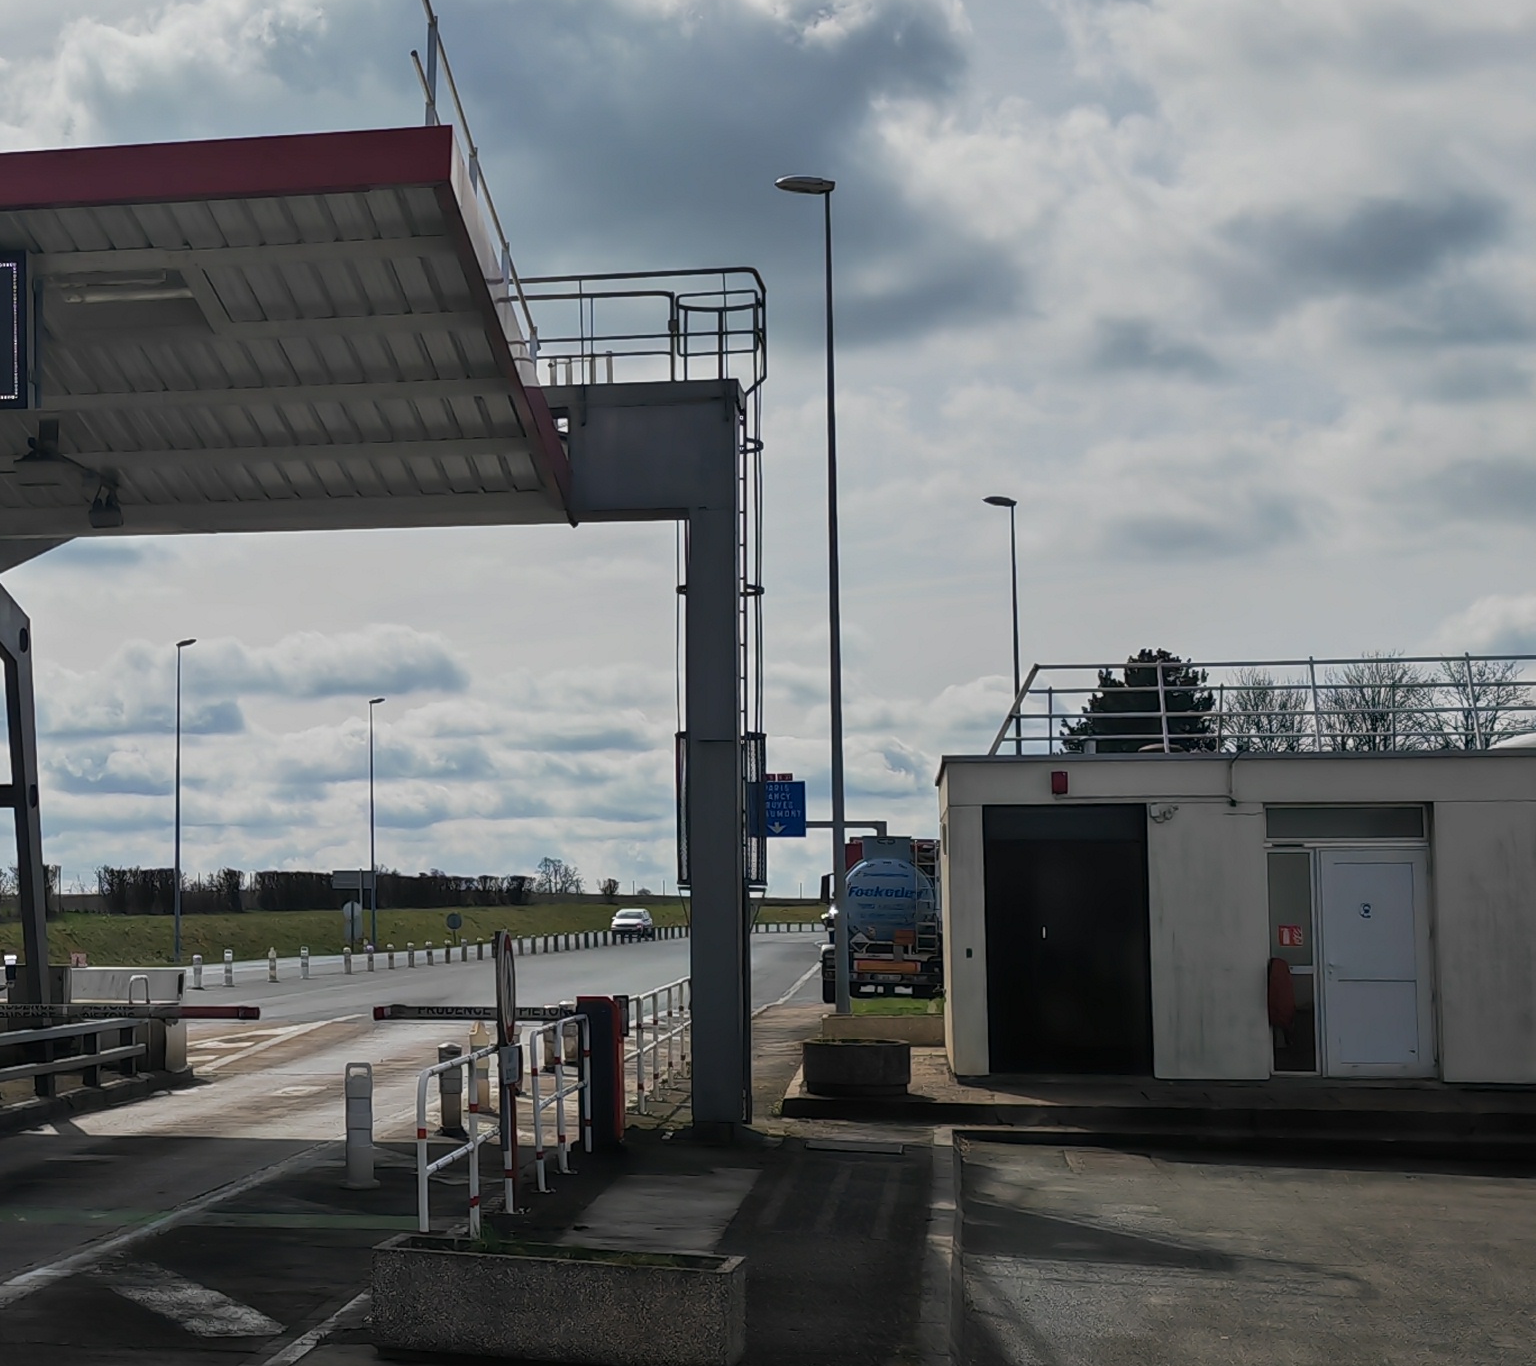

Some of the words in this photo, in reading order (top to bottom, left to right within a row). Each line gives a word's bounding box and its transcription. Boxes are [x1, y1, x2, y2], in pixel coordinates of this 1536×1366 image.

[767, 792, 791, 801] ANCY
[417, 1006, 491, 1016] PRUDENCE
[519, 1007, 571, 1017] PIETON
